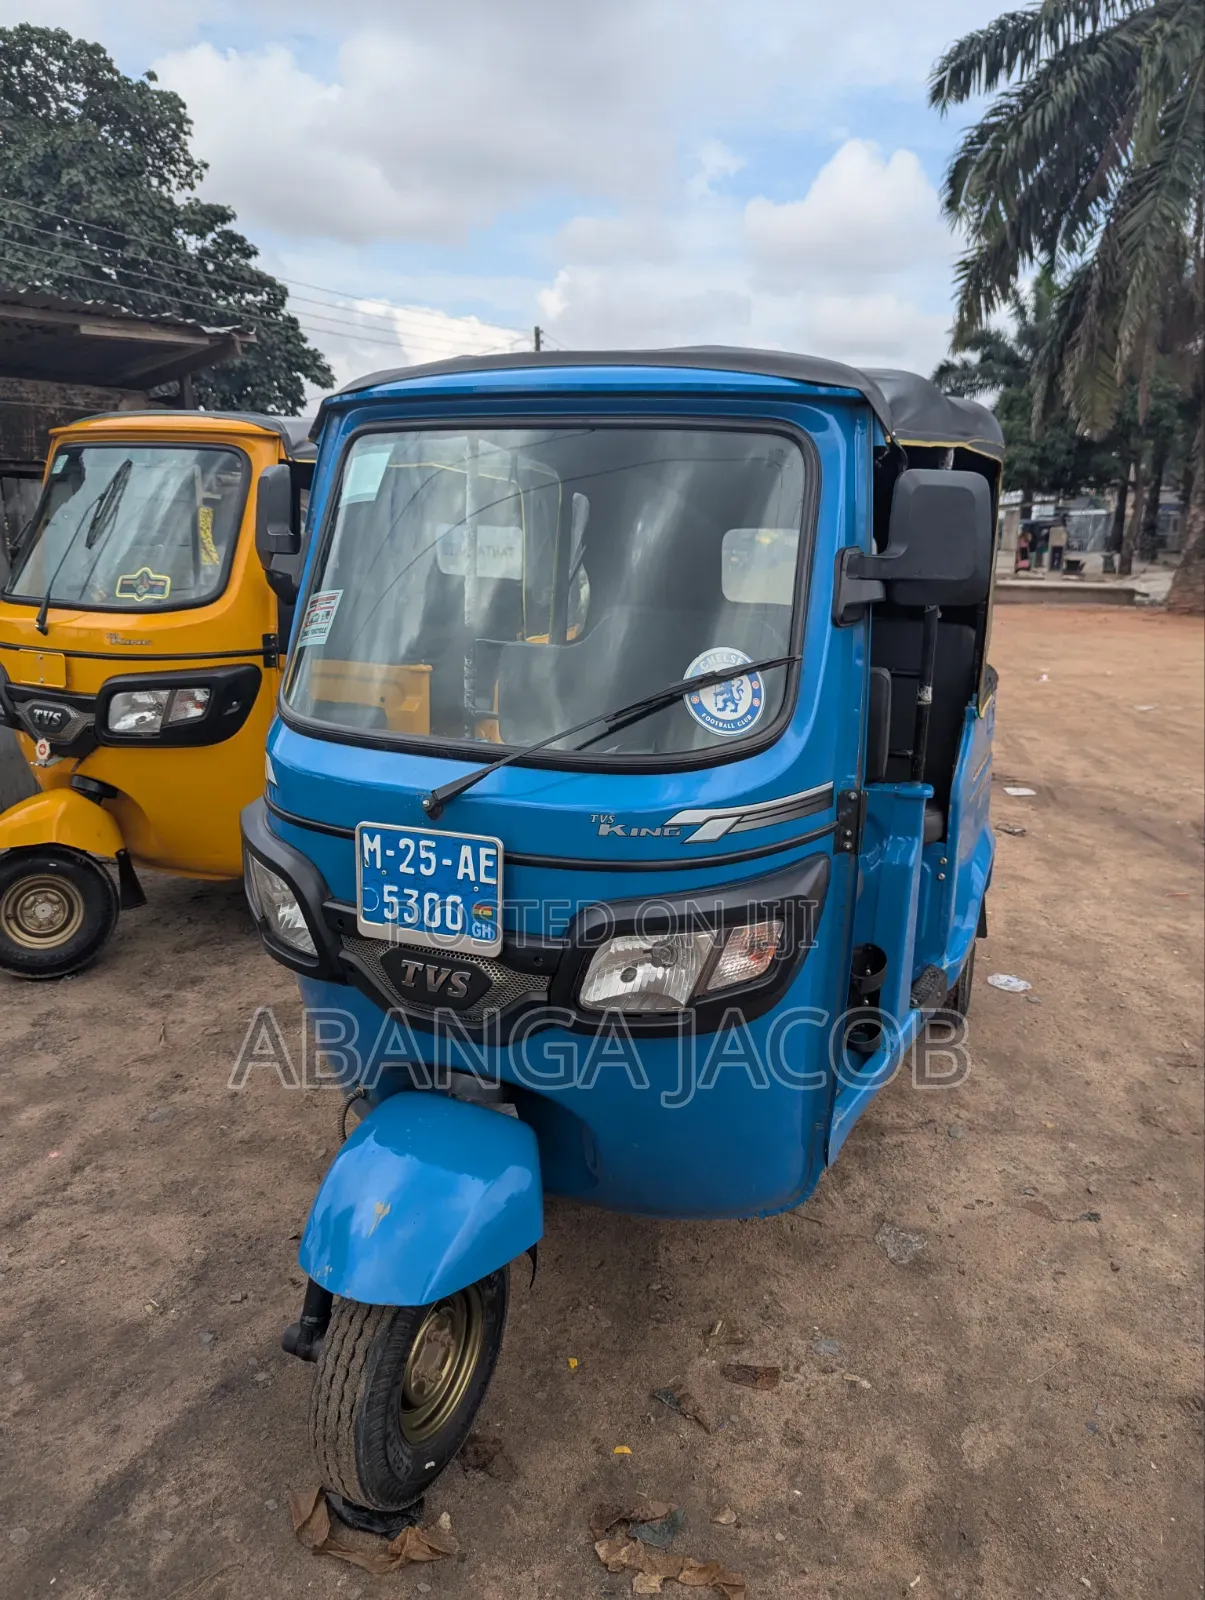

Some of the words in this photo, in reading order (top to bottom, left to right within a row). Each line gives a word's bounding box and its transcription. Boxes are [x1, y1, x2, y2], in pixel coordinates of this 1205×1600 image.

[700, 653, 744, 670] CHELSE
[33, 708, 62, 726] TVS
[701, 712, 735, 728] FOOTBALL
[737, 714, 752, 727] CLUB
[590, 814, 616, 824] TVS
[362, 833, 497, 884] M-25-AE
[383, 884, 463, 931] 5300
[472, 922, 492, 939] GH
[401, 959, 472, 998] TVS
